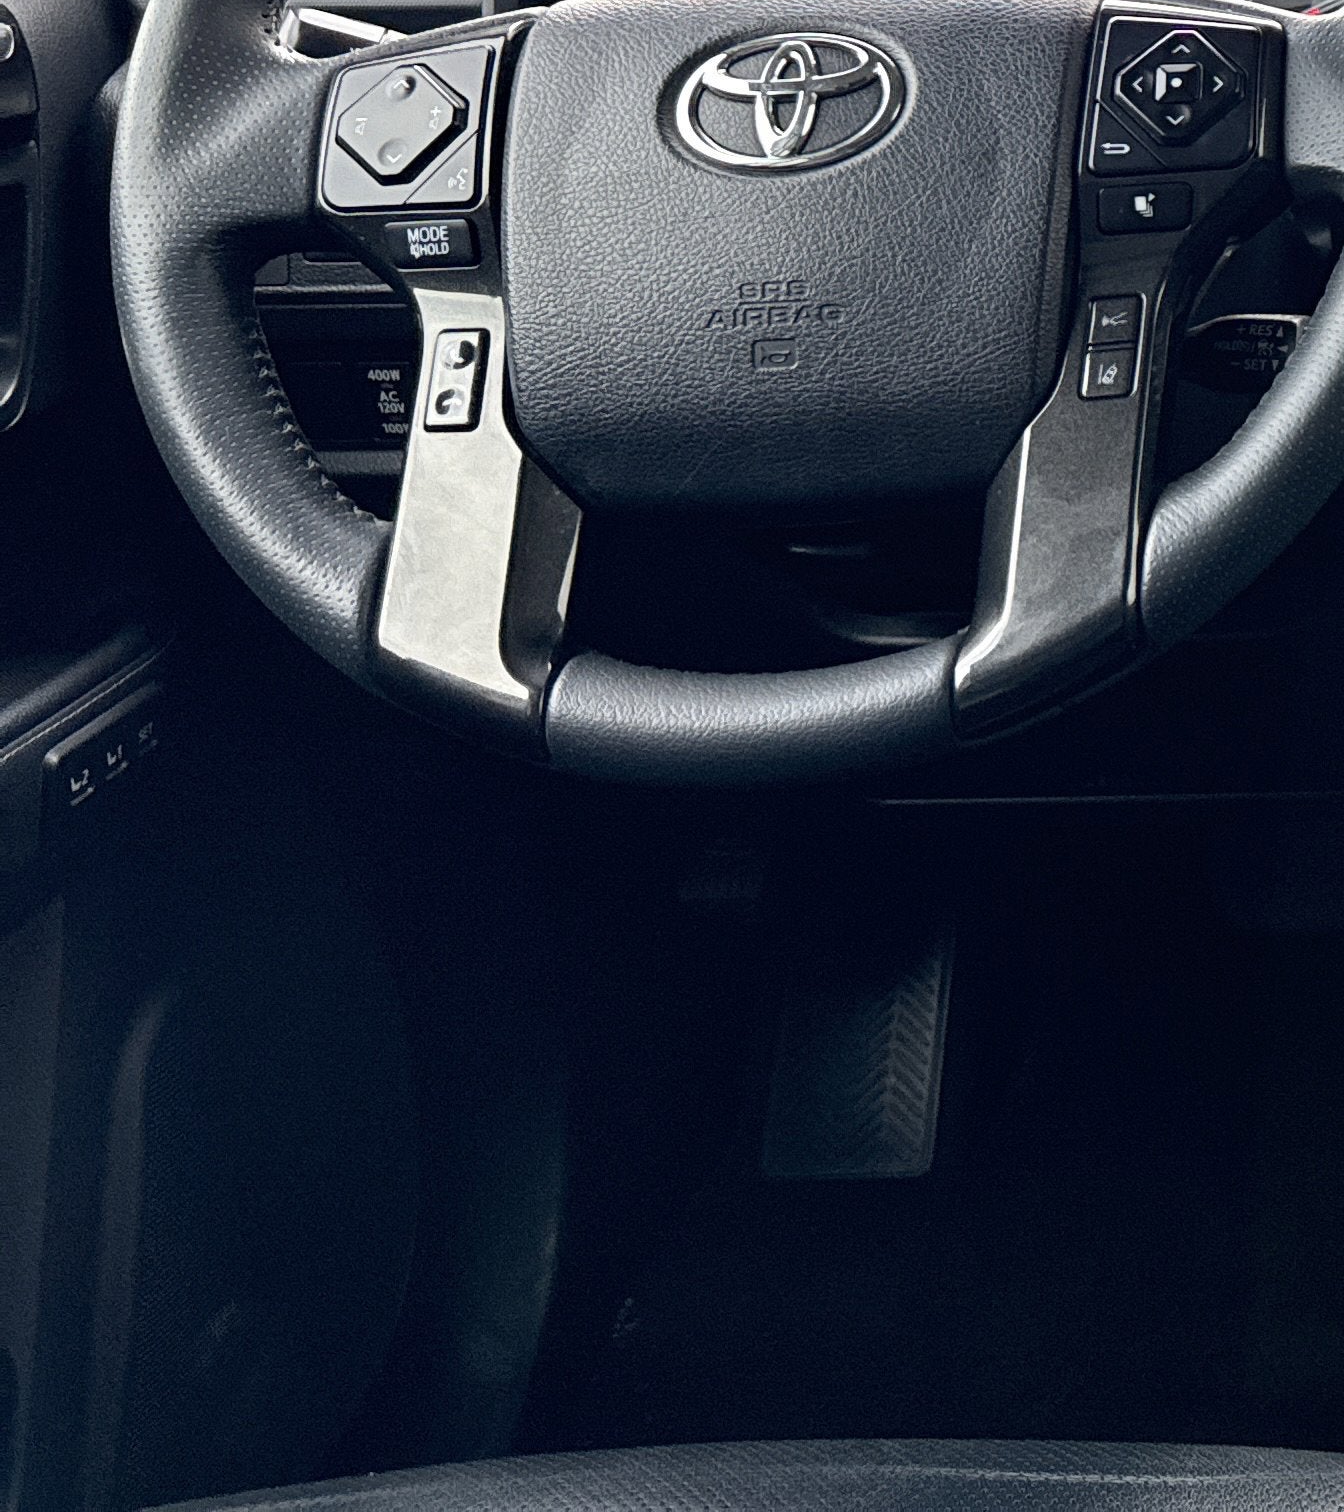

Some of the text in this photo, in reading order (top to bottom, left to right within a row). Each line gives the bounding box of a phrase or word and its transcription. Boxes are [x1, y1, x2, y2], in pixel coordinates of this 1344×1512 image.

[407, 226, 449, 243] MODE
[420, 242, 449, 256] HOLD
[704, 303, 846, 330] AIRBAG
[367, 369, 401, 382] 400W
[379, 391, 399, 402] AC
[377, 402, 405, 414] 120V
